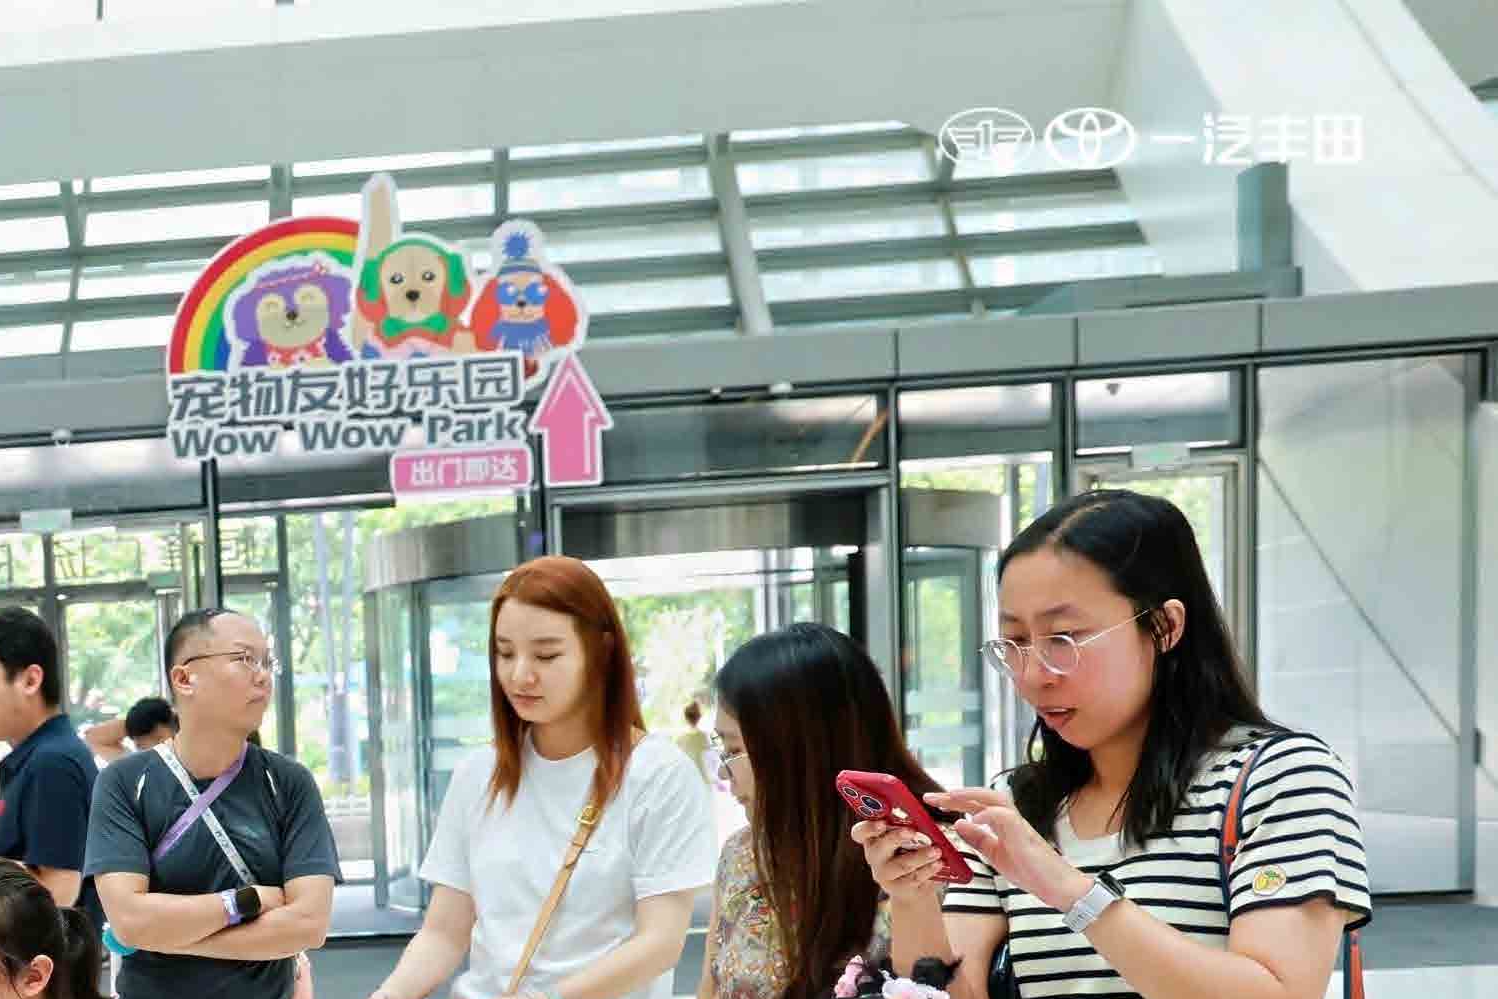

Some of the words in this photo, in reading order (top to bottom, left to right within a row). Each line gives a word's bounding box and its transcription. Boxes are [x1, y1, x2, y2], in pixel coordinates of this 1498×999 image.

[171, 356, 519, 422] 宠物友好乐园
[172, 428, 278, 457] Wow
[300, 421, 404, 450] Wow
[427, 411, 524, 444] Park
